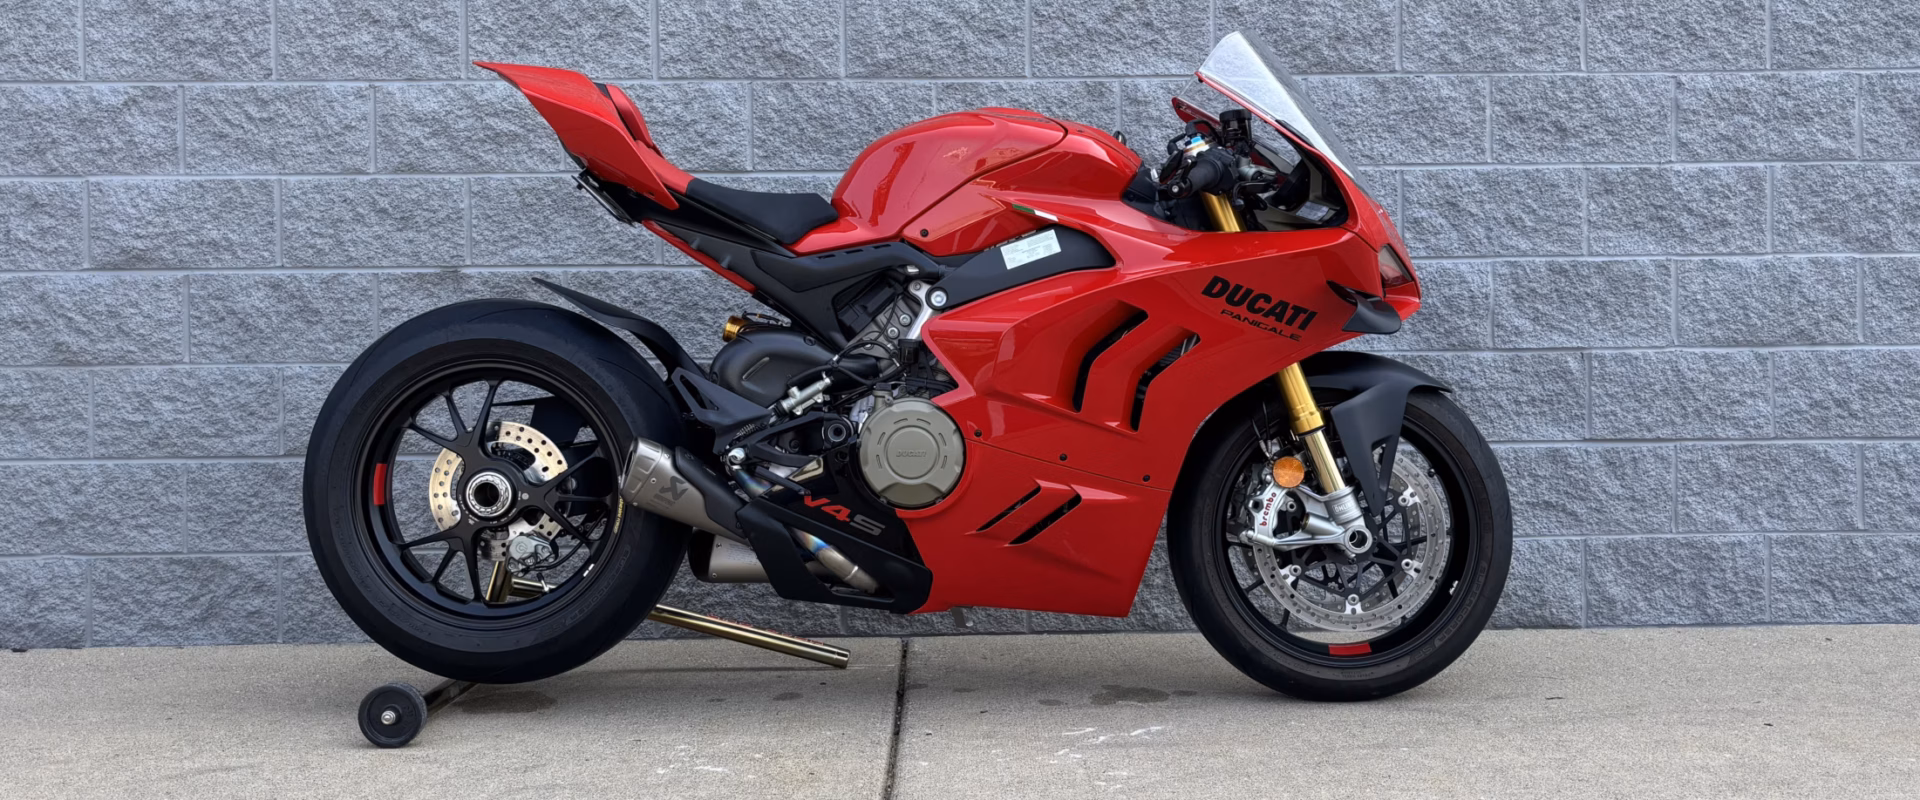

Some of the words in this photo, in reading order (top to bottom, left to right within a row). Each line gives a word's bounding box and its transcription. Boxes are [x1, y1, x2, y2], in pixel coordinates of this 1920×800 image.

[1201, 275, 1318, 331] DUCATI
[1220, 308, 1303, 342] PANIGALE
[896, 449, 927, 458] DUCATI
[1259, 492, 1277, 527] brembo
[1438, 565, 1487, 641] SUPERCORSA
[1414, 645, 1433, 661] SP
